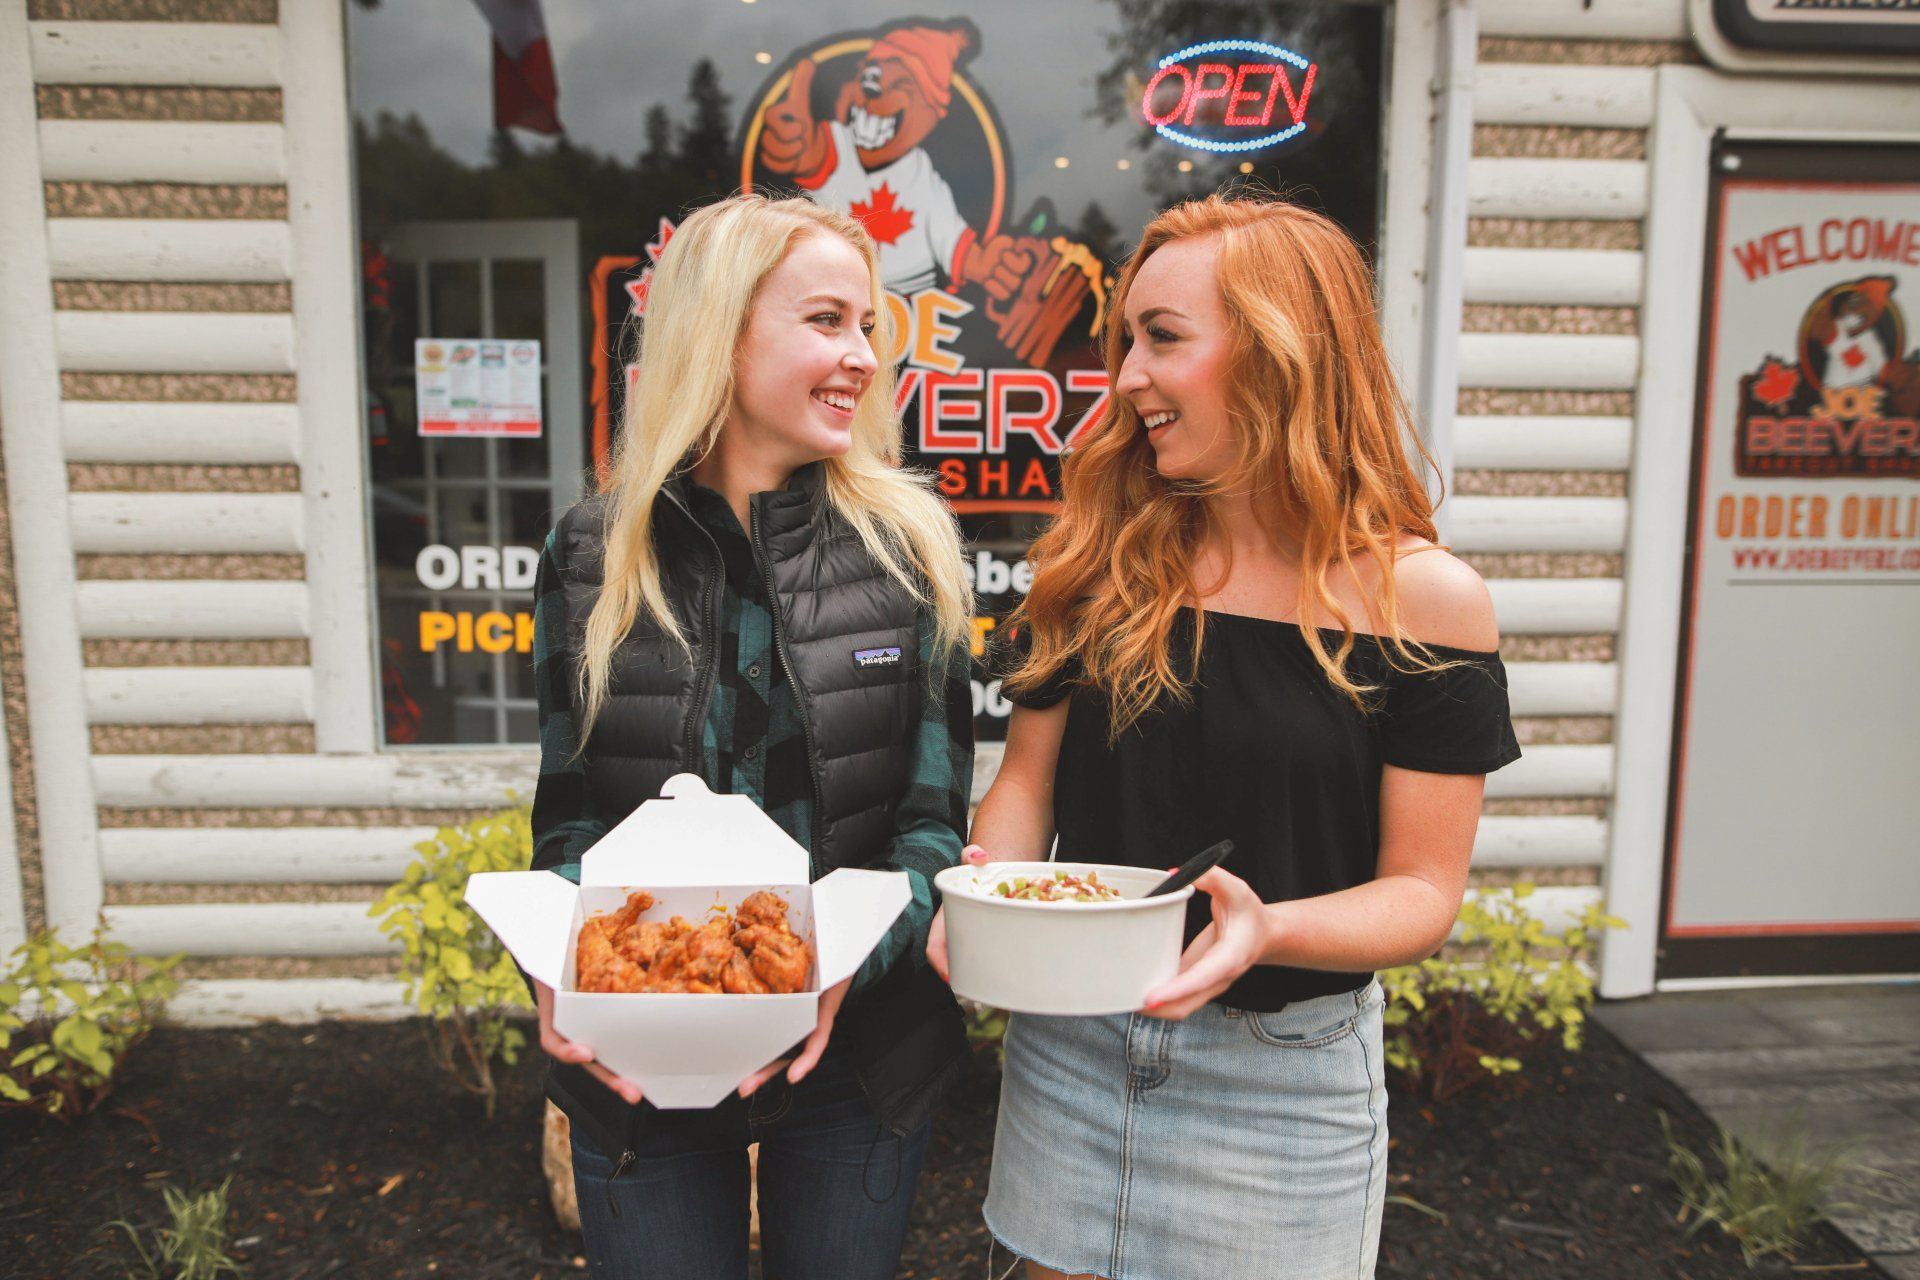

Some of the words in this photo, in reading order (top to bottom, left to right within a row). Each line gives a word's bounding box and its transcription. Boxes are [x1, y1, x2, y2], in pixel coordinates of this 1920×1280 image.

[1143, 64, 1317, 125] OPEN
[1733, 217, 1920, 284] WELCOME
[1810, 385, 1886, 420] JOE
[1747, 417, 1920, 456] BEEVER
[938, 458, 1051, 495] SHA
[1716, 495, 1828, 540] ORDER
[415, 543, 540, 591] ORD
[860, 654, 899, 667] patagonia
